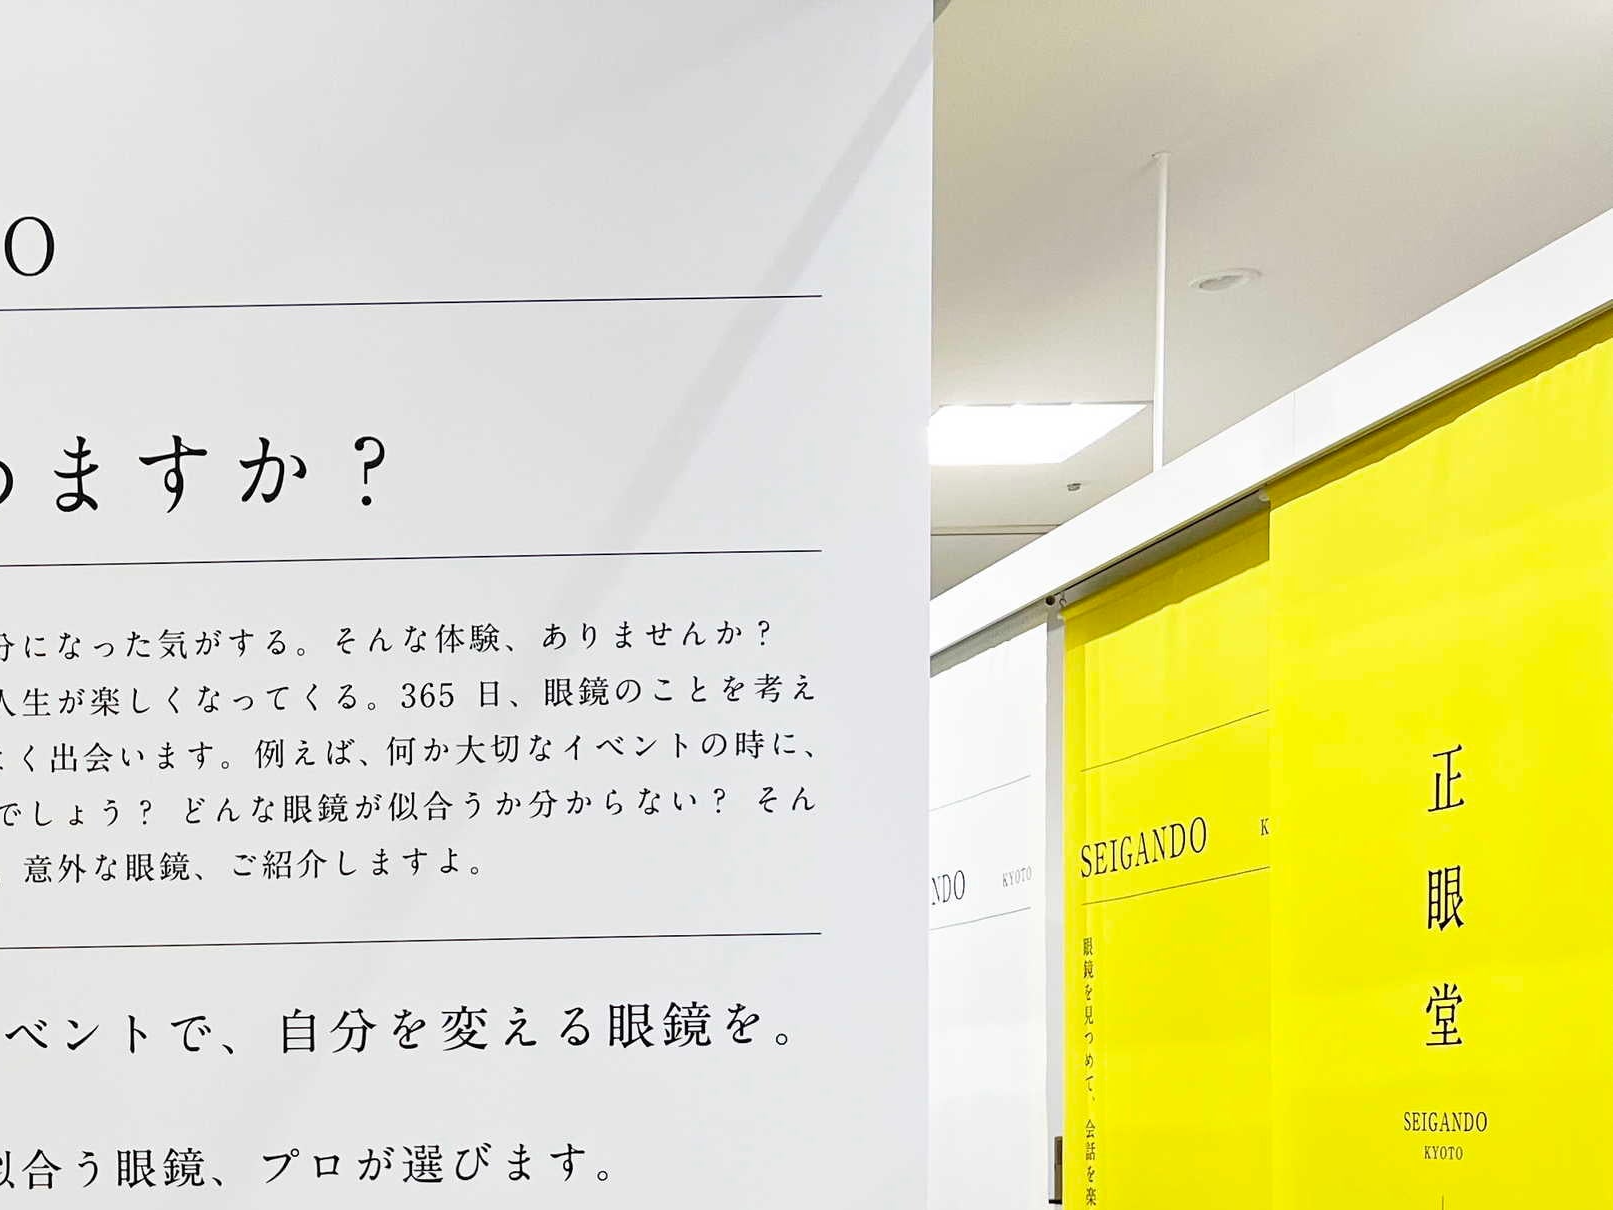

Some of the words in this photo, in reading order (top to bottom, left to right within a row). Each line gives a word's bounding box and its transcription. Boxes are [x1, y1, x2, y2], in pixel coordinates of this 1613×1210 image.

[1080, 816, 1208, 878] SEIGANDO
[1001, 865, 1033, 889] KYOTO
[1425, 743, 1465, 1047] 正眼堂
[1403, 1111, 1488, 1133] SEIGANDO
[1424, 1145, 1464, 1161] KYOTO
